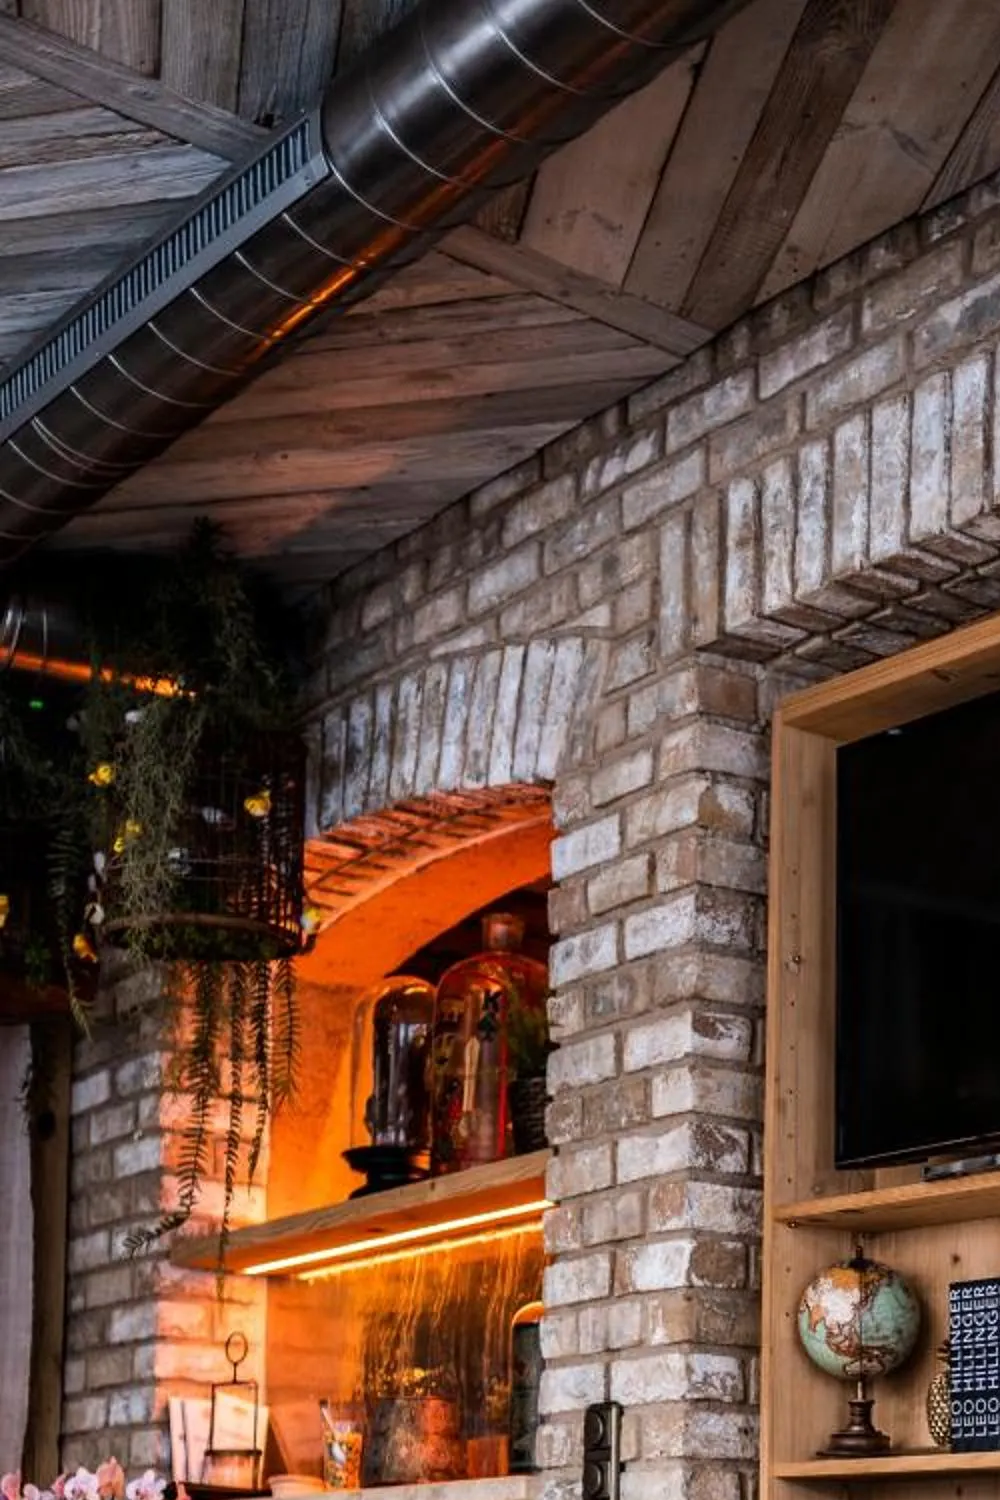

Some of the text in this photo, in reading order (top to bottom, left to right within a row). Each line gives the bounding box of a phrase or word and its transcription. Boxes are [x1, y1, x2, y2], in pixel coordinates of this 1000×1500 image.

[950, 1289, 963, 1439] LEO HILLINGER
[961, 1287, 975, 1437] LEO HILLINGER
[973, 1286, 987, 1437] LEO HILLINGER
[985, 1284, 1000, 1436] LEO HILLINGER
